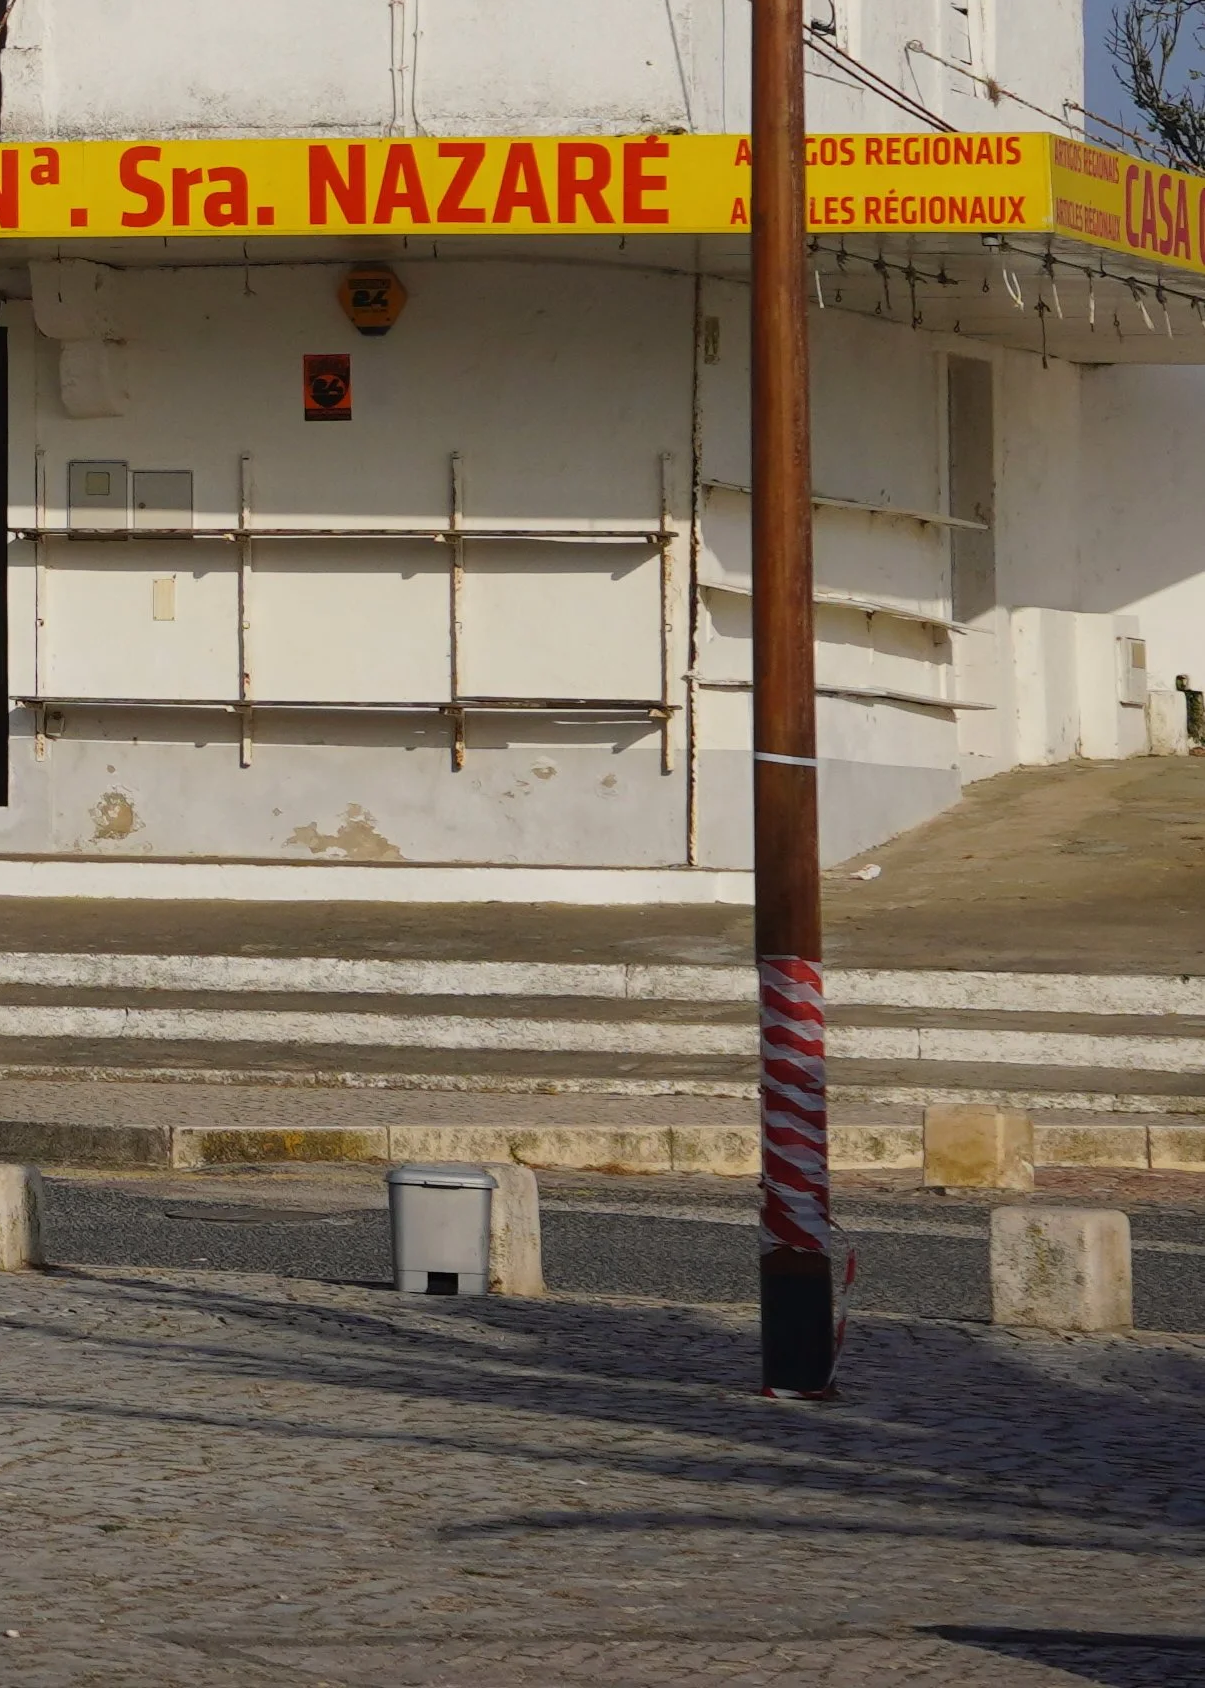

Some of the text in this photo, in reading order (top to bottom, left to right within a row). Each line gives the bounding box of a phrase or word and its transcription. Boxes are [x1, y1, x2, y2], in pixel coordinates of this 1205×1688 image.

[118, 145, 275, 228] Sra.
[307, 135, 670, 226] NAZARÉ
[734, 136, 1023, 167] AGOS REGIONAIS
[730, 188, 1027, 225] ALES RÉGIONAUX
[1126, 164, 1192, 260] CASA
